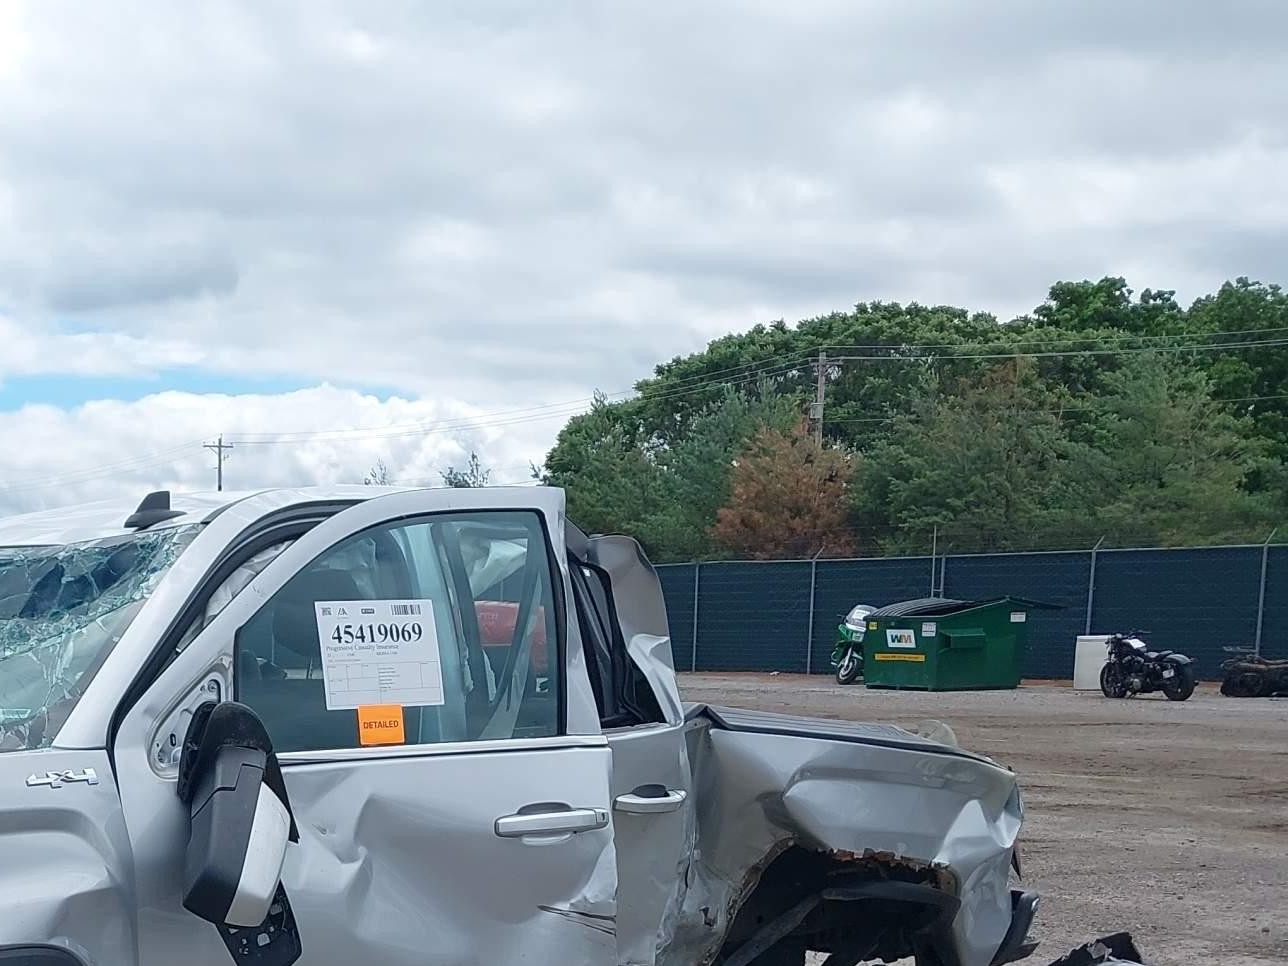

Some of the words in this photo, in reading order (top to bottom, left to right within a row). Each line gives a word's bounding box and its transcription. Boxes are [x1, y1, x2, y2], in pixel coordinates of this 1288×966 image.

[331, 622, 423, 644] 45419069
[890, 633, 913, 644] WM
[363, 719, 399, 729] DETAILED
